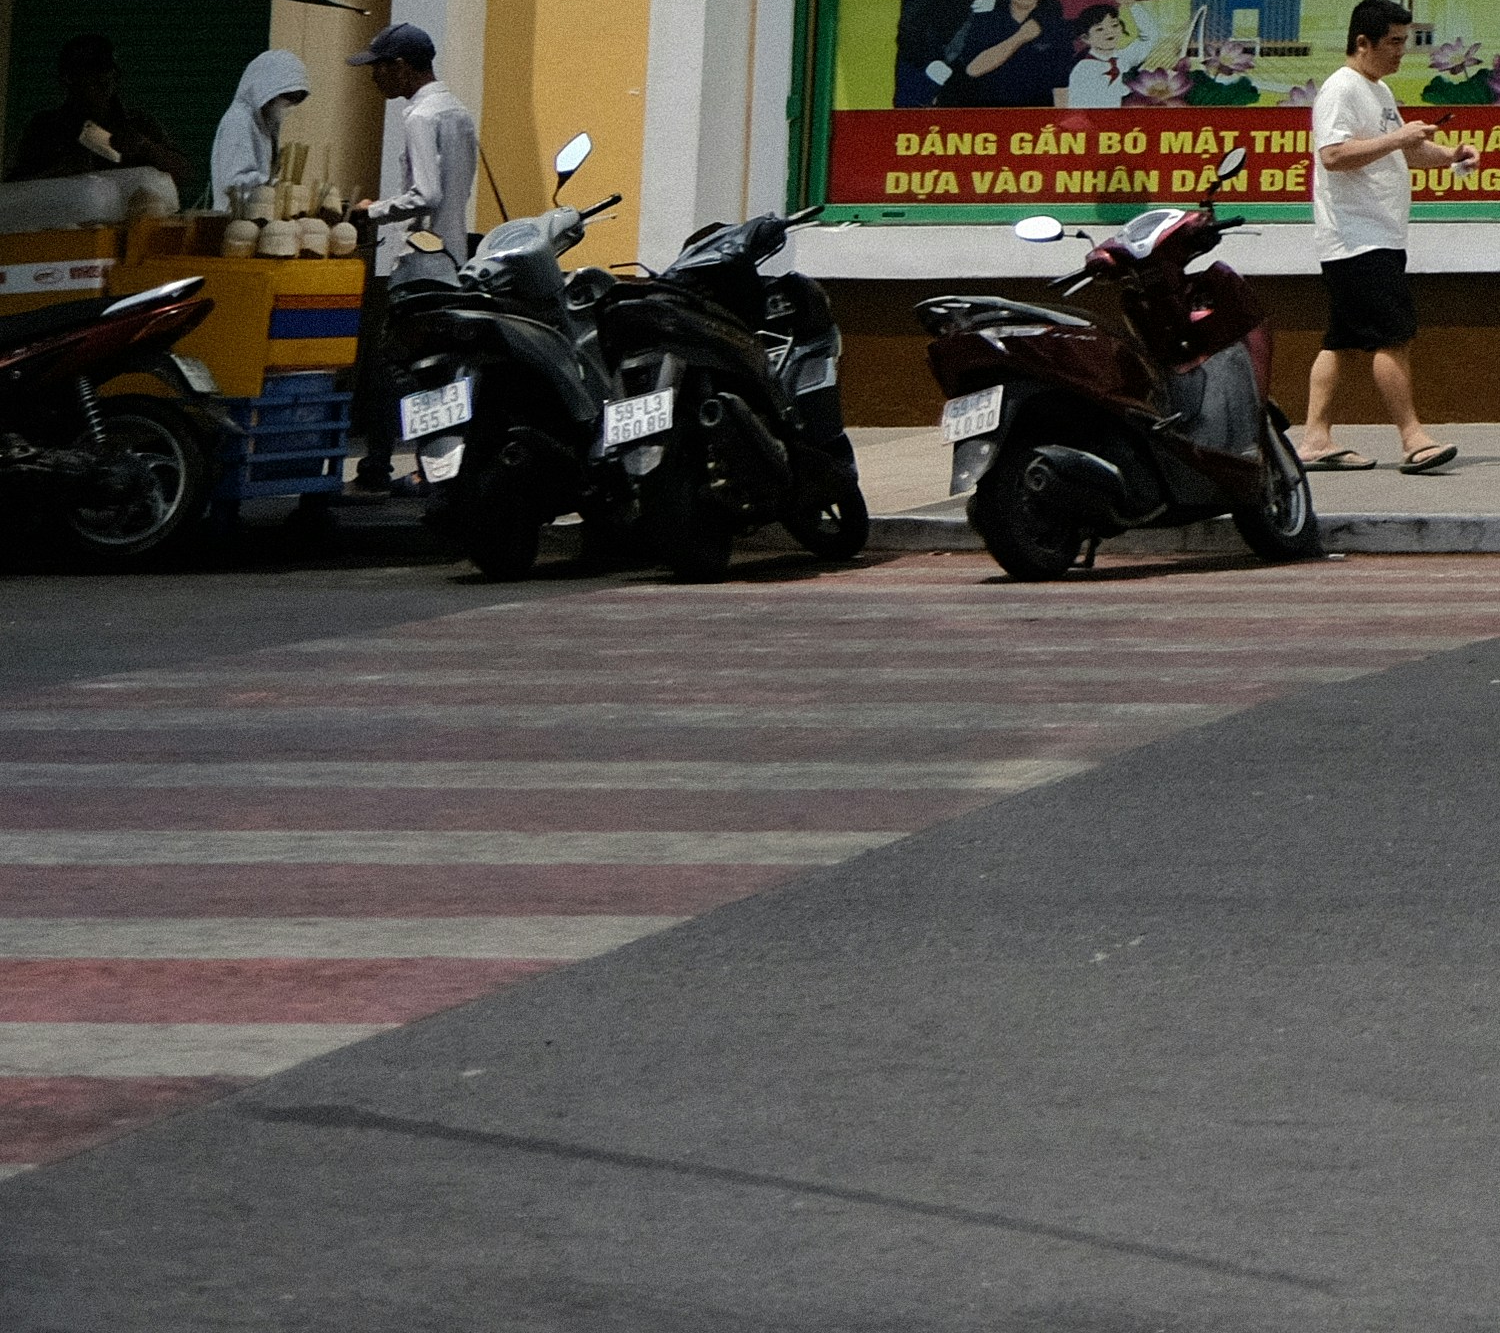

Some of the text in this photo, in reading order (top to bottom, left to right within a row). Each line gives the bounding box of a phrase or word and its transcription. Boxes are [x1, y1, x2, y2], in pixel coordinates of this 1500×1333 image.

[896, 125, 998, 157] ĐẢNG
[1009, 123, 1087, 156] GẮN
[1098, 126, 1147, 156] BÓ
[1159, 126, 1240, 159] MẬT
[1250, 130, 1314, 154] THI
[885, 167, 960, 200] DỰA
[970, 165, 1043, 194] VÀO
[1054, 165, 1160, 194] NHÂN
[1170, 165, 1249, 194] DÂN
[1259, 158, 1310, 194] ĐỂ
[614, 394, 664, 423] 59-L3
